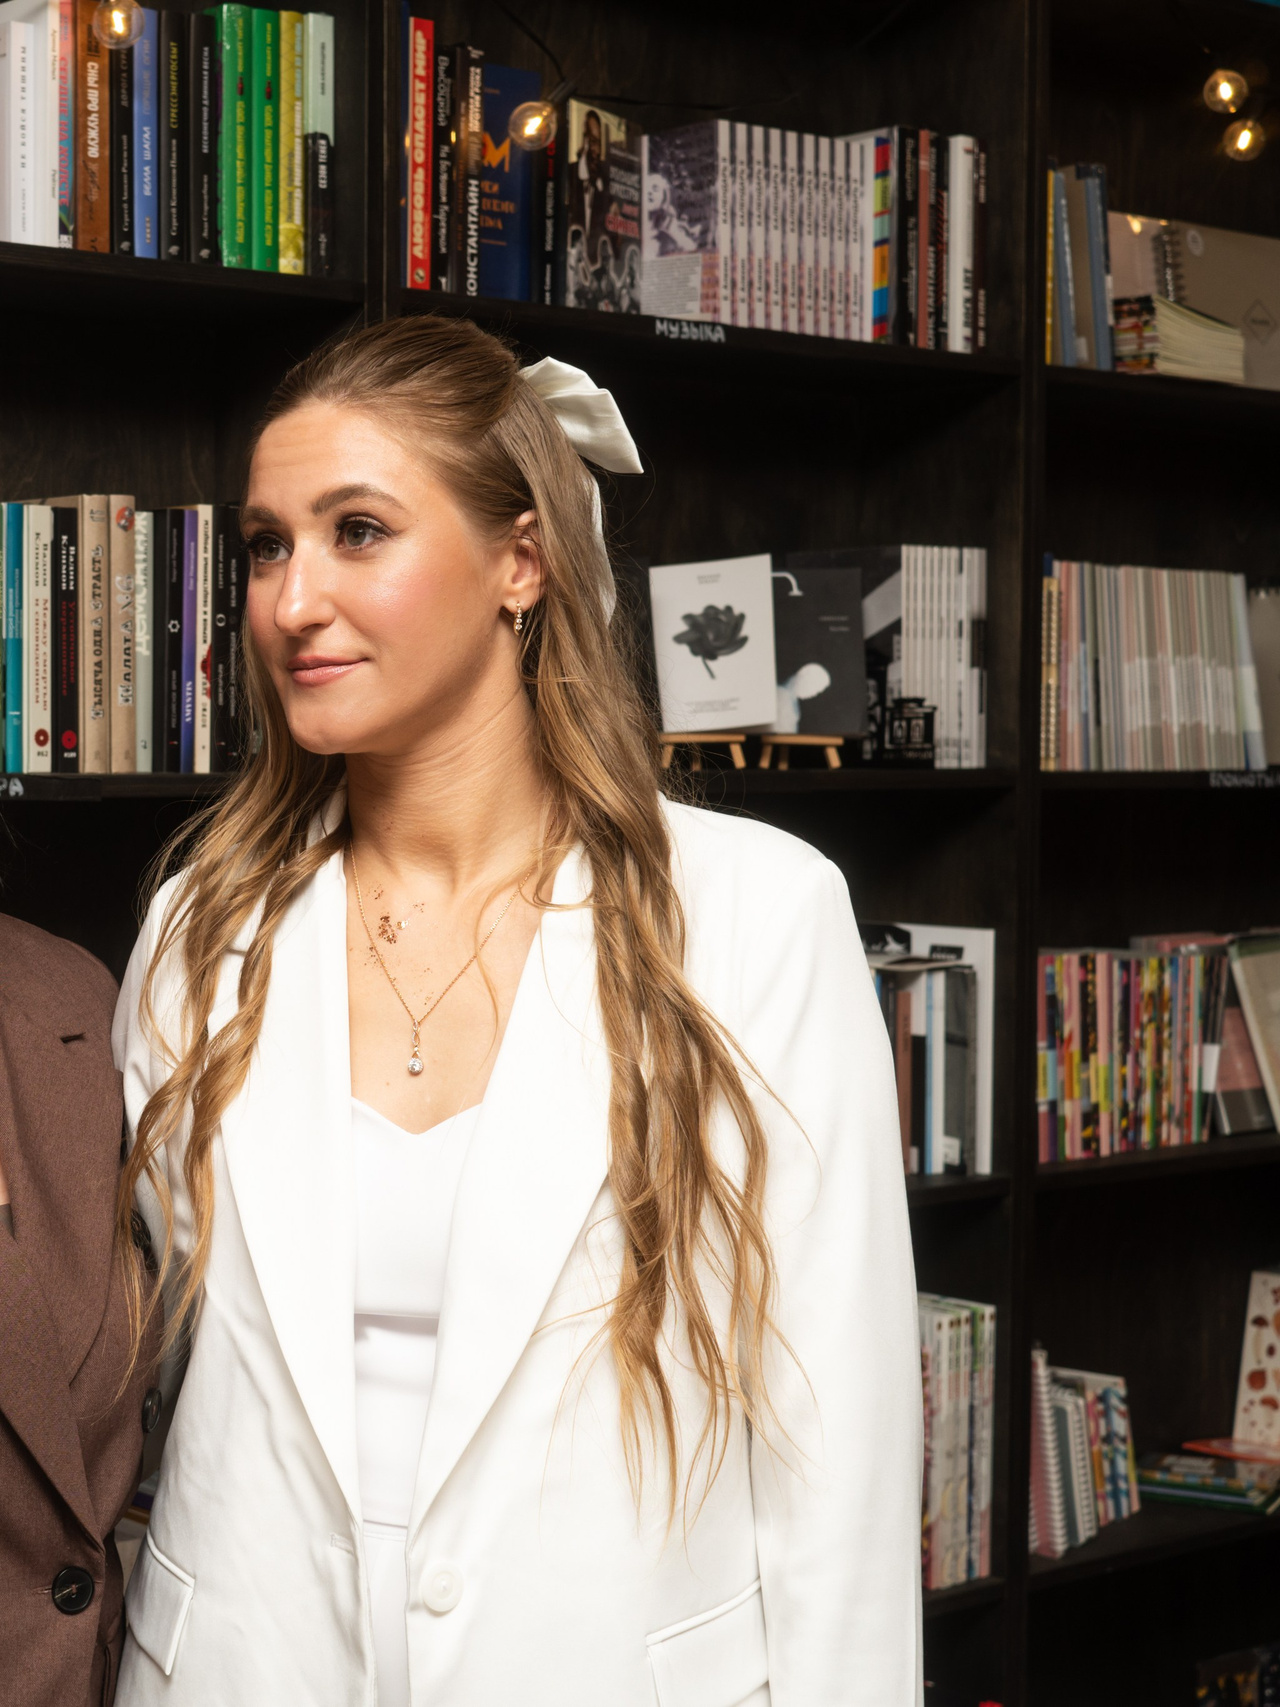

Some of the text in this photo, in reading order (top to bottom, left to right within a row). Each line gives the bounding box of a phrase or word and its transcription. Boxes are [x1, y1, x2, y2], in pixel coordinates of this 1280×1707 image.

[87, 61, 100, 90] СНЫ
[87, 92, 100, 111] ПРО
[58, 56, 71, 207] СЕРДЦЕ НА ХОЛСТЕ
[87, 113, 100, 158] ЧУЖУЮ
[413, 29, 426, 259] ЛЮБОВЬ СПАСЕТ МИР
[318, 138, 328, 189] СЕЗОН ТЕНЕЙ
[655, 318, 725, 343] МУЗЫКА
[61, 535, 69, 591] Климов
[68, 546, 76, 591] Вадим
[92, 617, 103, 656] ОДНА
[41, 651, 49, 712] смертью
[91, 659, 104, 720] ТЫСЯЧА
